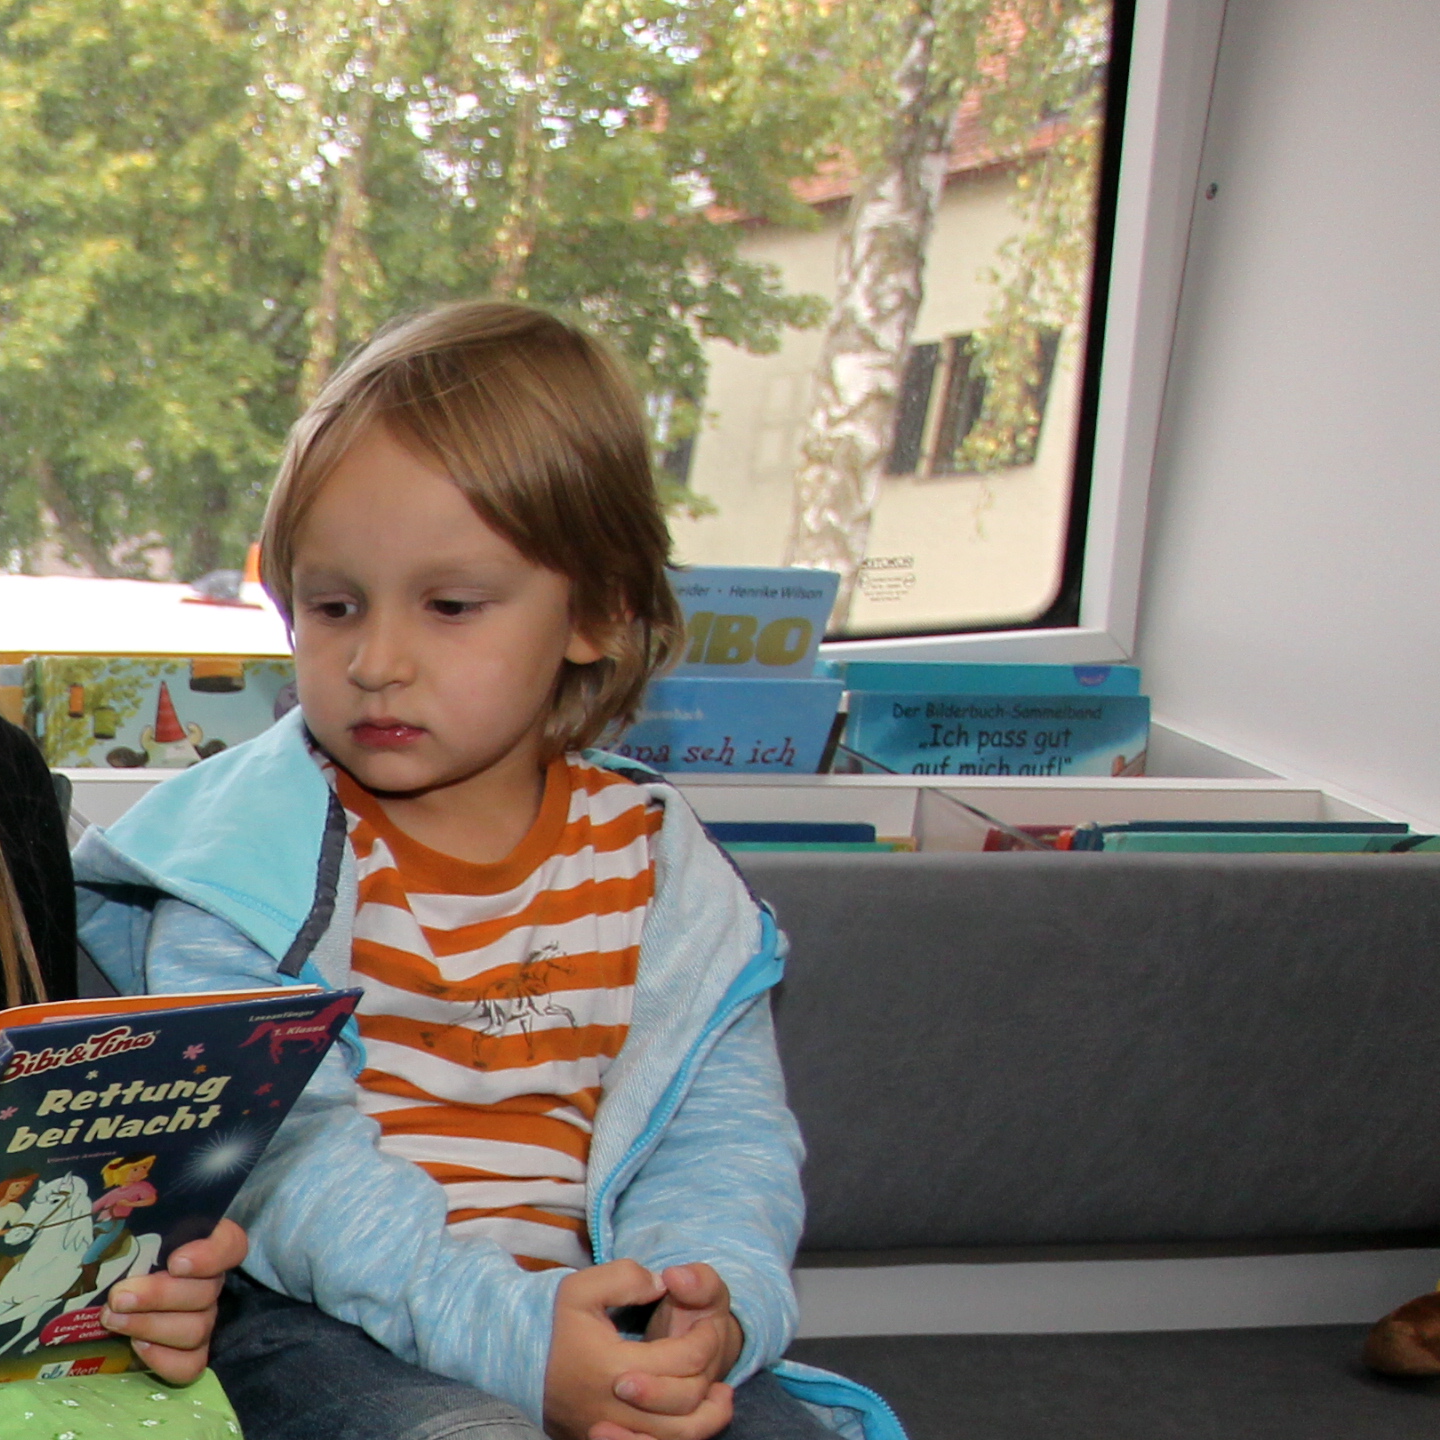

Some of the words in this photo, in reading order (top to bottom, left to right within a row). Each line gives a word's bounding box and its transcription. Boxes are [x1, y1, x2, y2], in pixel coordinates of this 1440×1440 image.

[729, 585, 779, 599] Henrike
[781, 585, 823, 600] Wilson
[893, 703, 921, 718] Der
[926, 703, 1104, 720] Bilderbuch-Sammelband
[682, 736, 734, 767] seh
[747, 736, 798, 767] ich
[978, 728, 1026, 751] pass
[1034, 725, 1073, 755] gut
[912, 756, 950, 775] auf
[959, 756, 1011, 775] mich
[286, 1023, 327, 1037] Klasse
[2, 1048, 62, 1082] Bibi
[88, 1027, 156, 1060] Tina
[36, 1075, 232, 1117] Rettung
[6, 1124, 80, 1154] bei
[84, 1104, 223, 1144] Nacht
[68, 1365, 99, 1377] Klett
